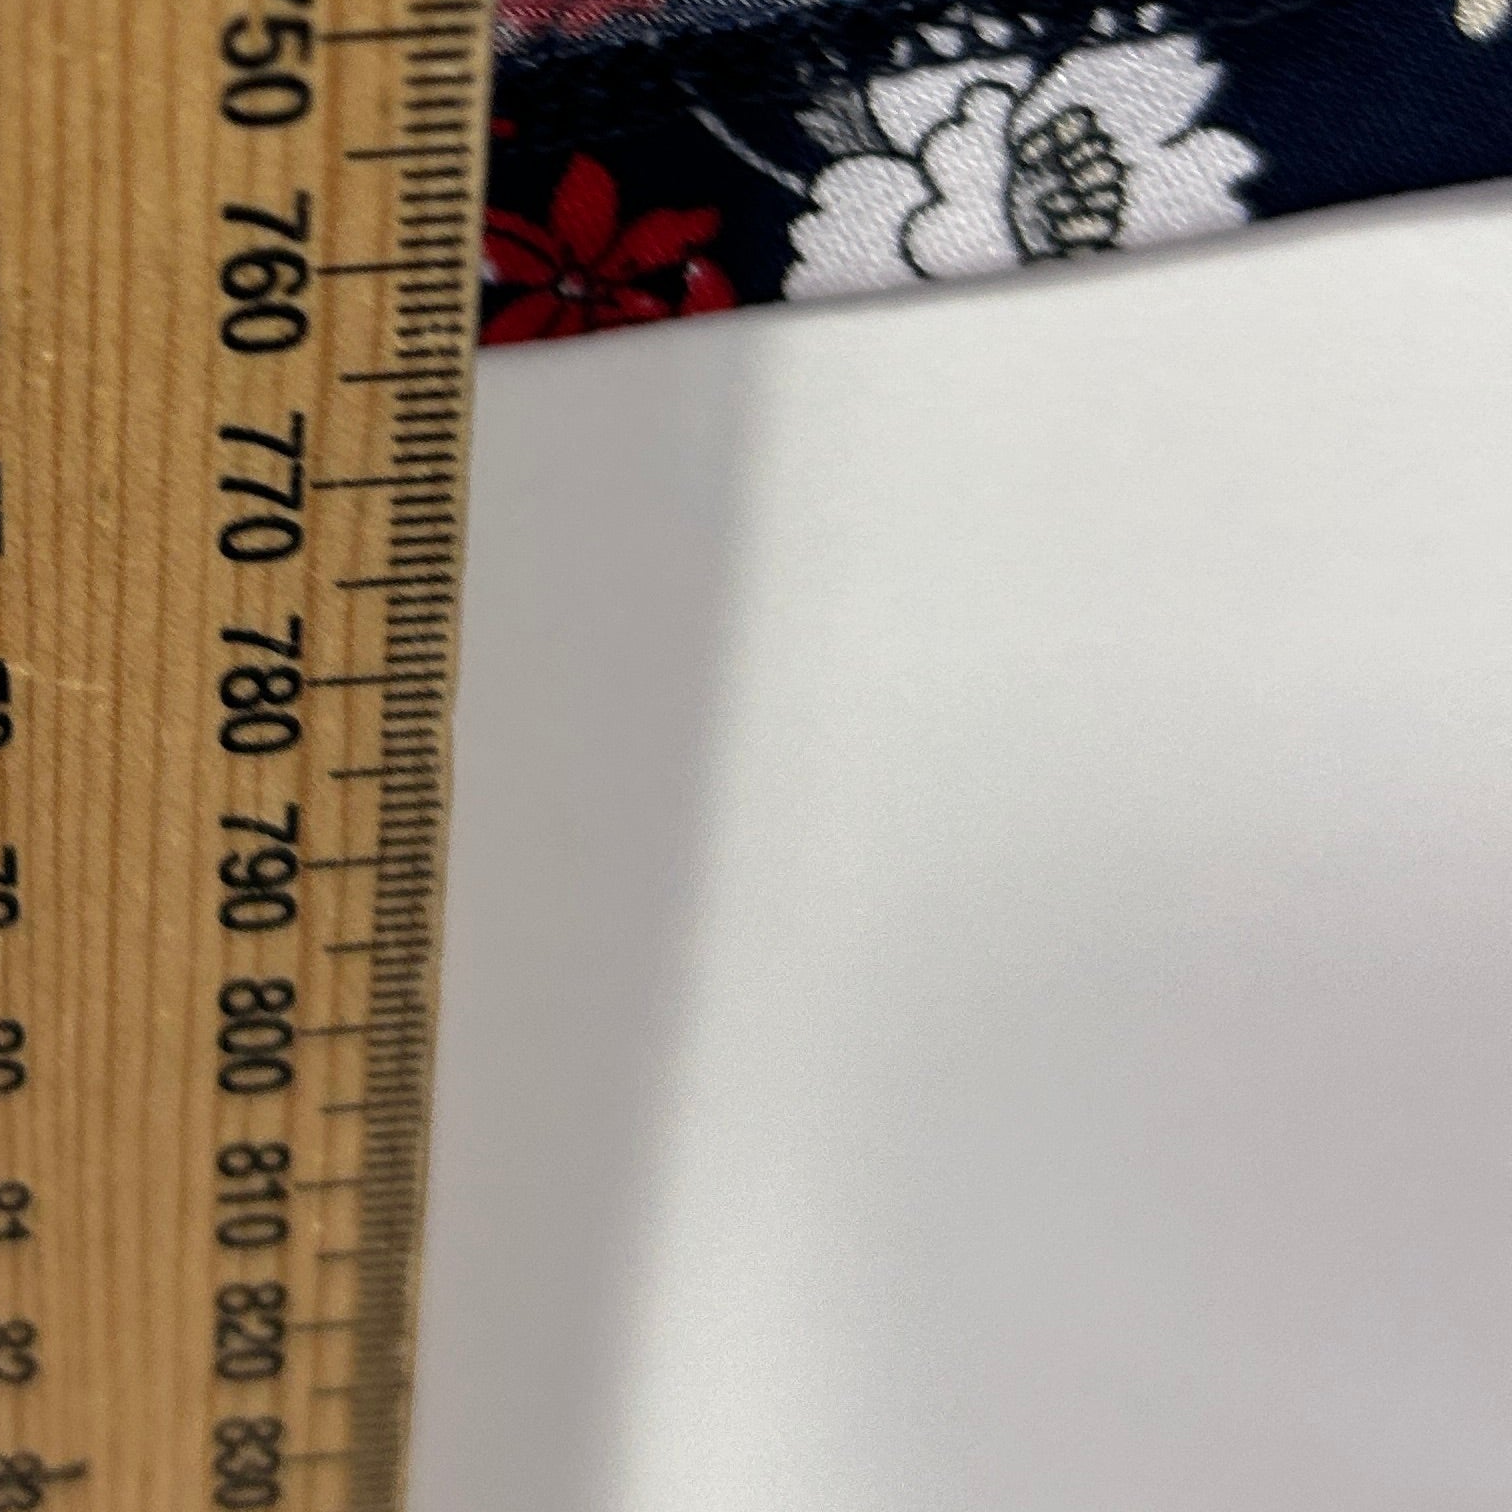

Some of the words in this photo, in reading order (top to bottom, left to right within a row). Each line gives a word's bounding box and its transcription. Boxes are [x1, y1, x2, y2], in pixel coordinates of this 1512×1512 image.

[216, 187, 314, 358] 760
[214, 408, 308, 569] 770
[216, 611, 306, 760] 780
[216, 799, 303, 936] 790
[214, 975, 300, 1099] 800
[211, 1136, 294, 1254] 810
[208, 1277, 291, 1386] 820
[207, 1412, 289, 1512] 830
